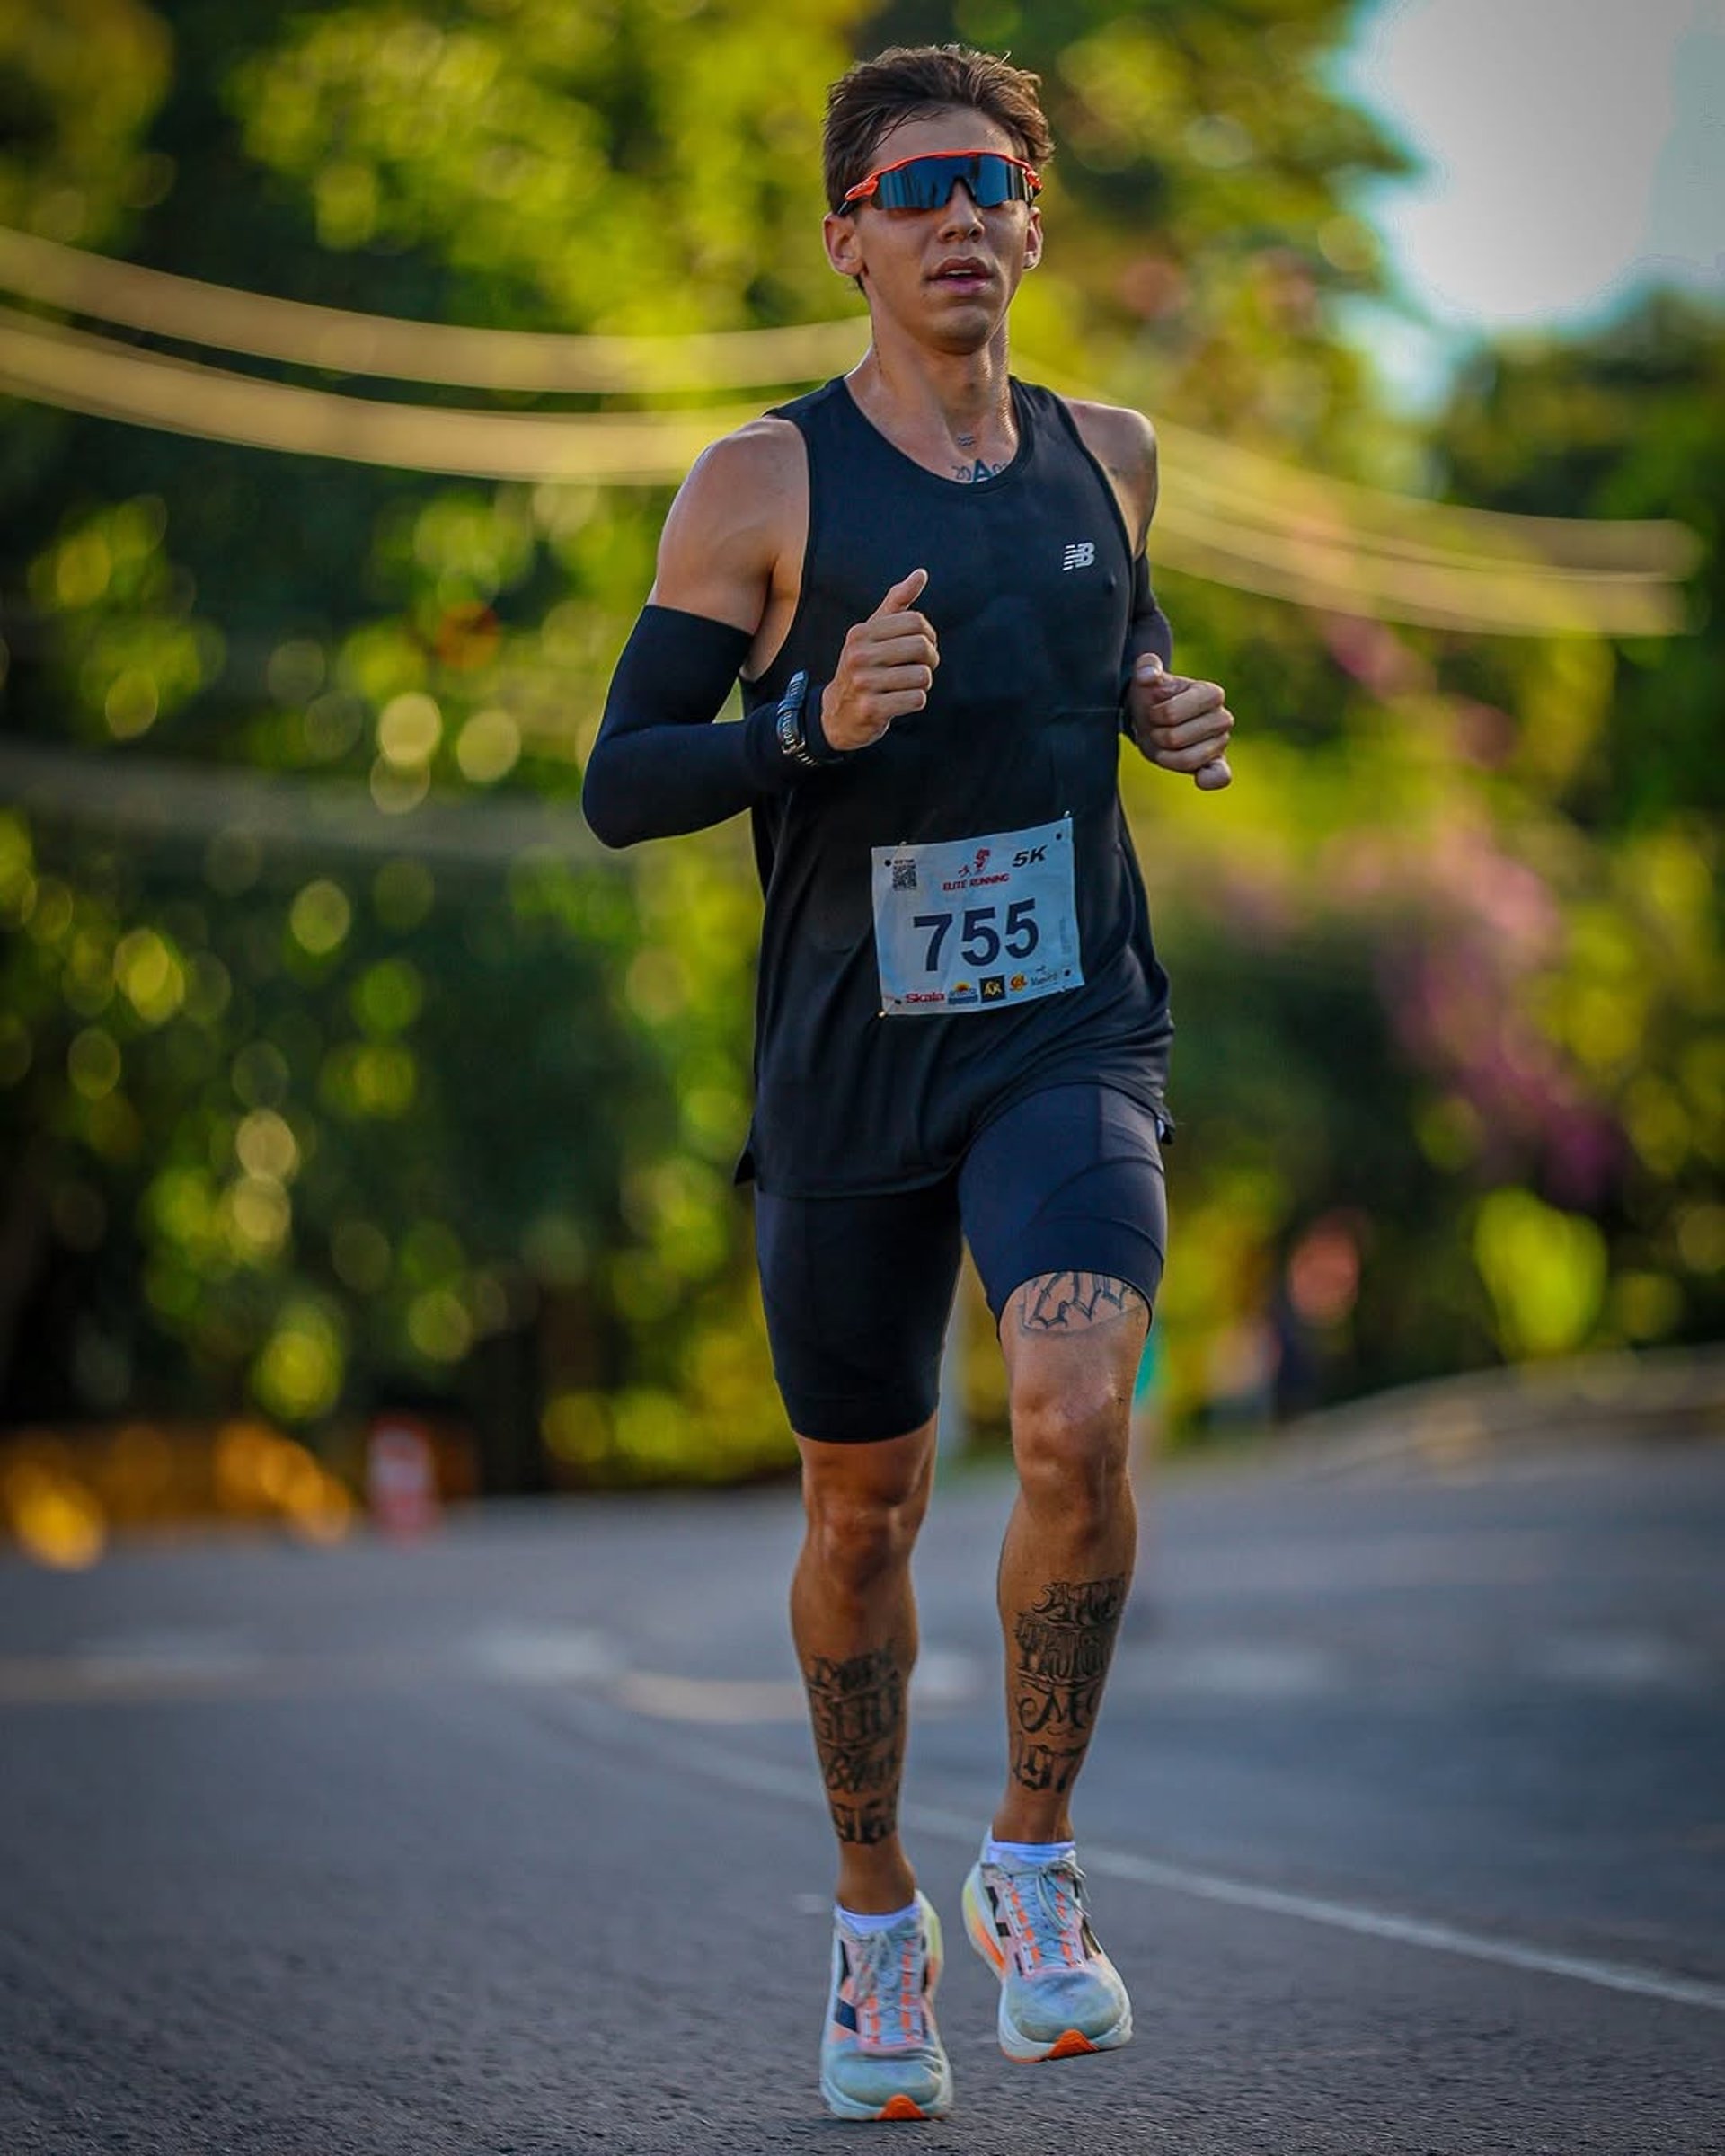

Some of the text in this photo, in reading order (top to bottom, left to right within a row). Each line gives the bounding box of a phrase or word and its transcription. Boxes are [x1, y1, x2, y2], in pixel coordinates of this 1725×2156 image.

[1013, 845, 1047, 868] 5K
[942, 873, 1010, 891] ELITE RUNNING
[913, 898, 1039, 972] 755
